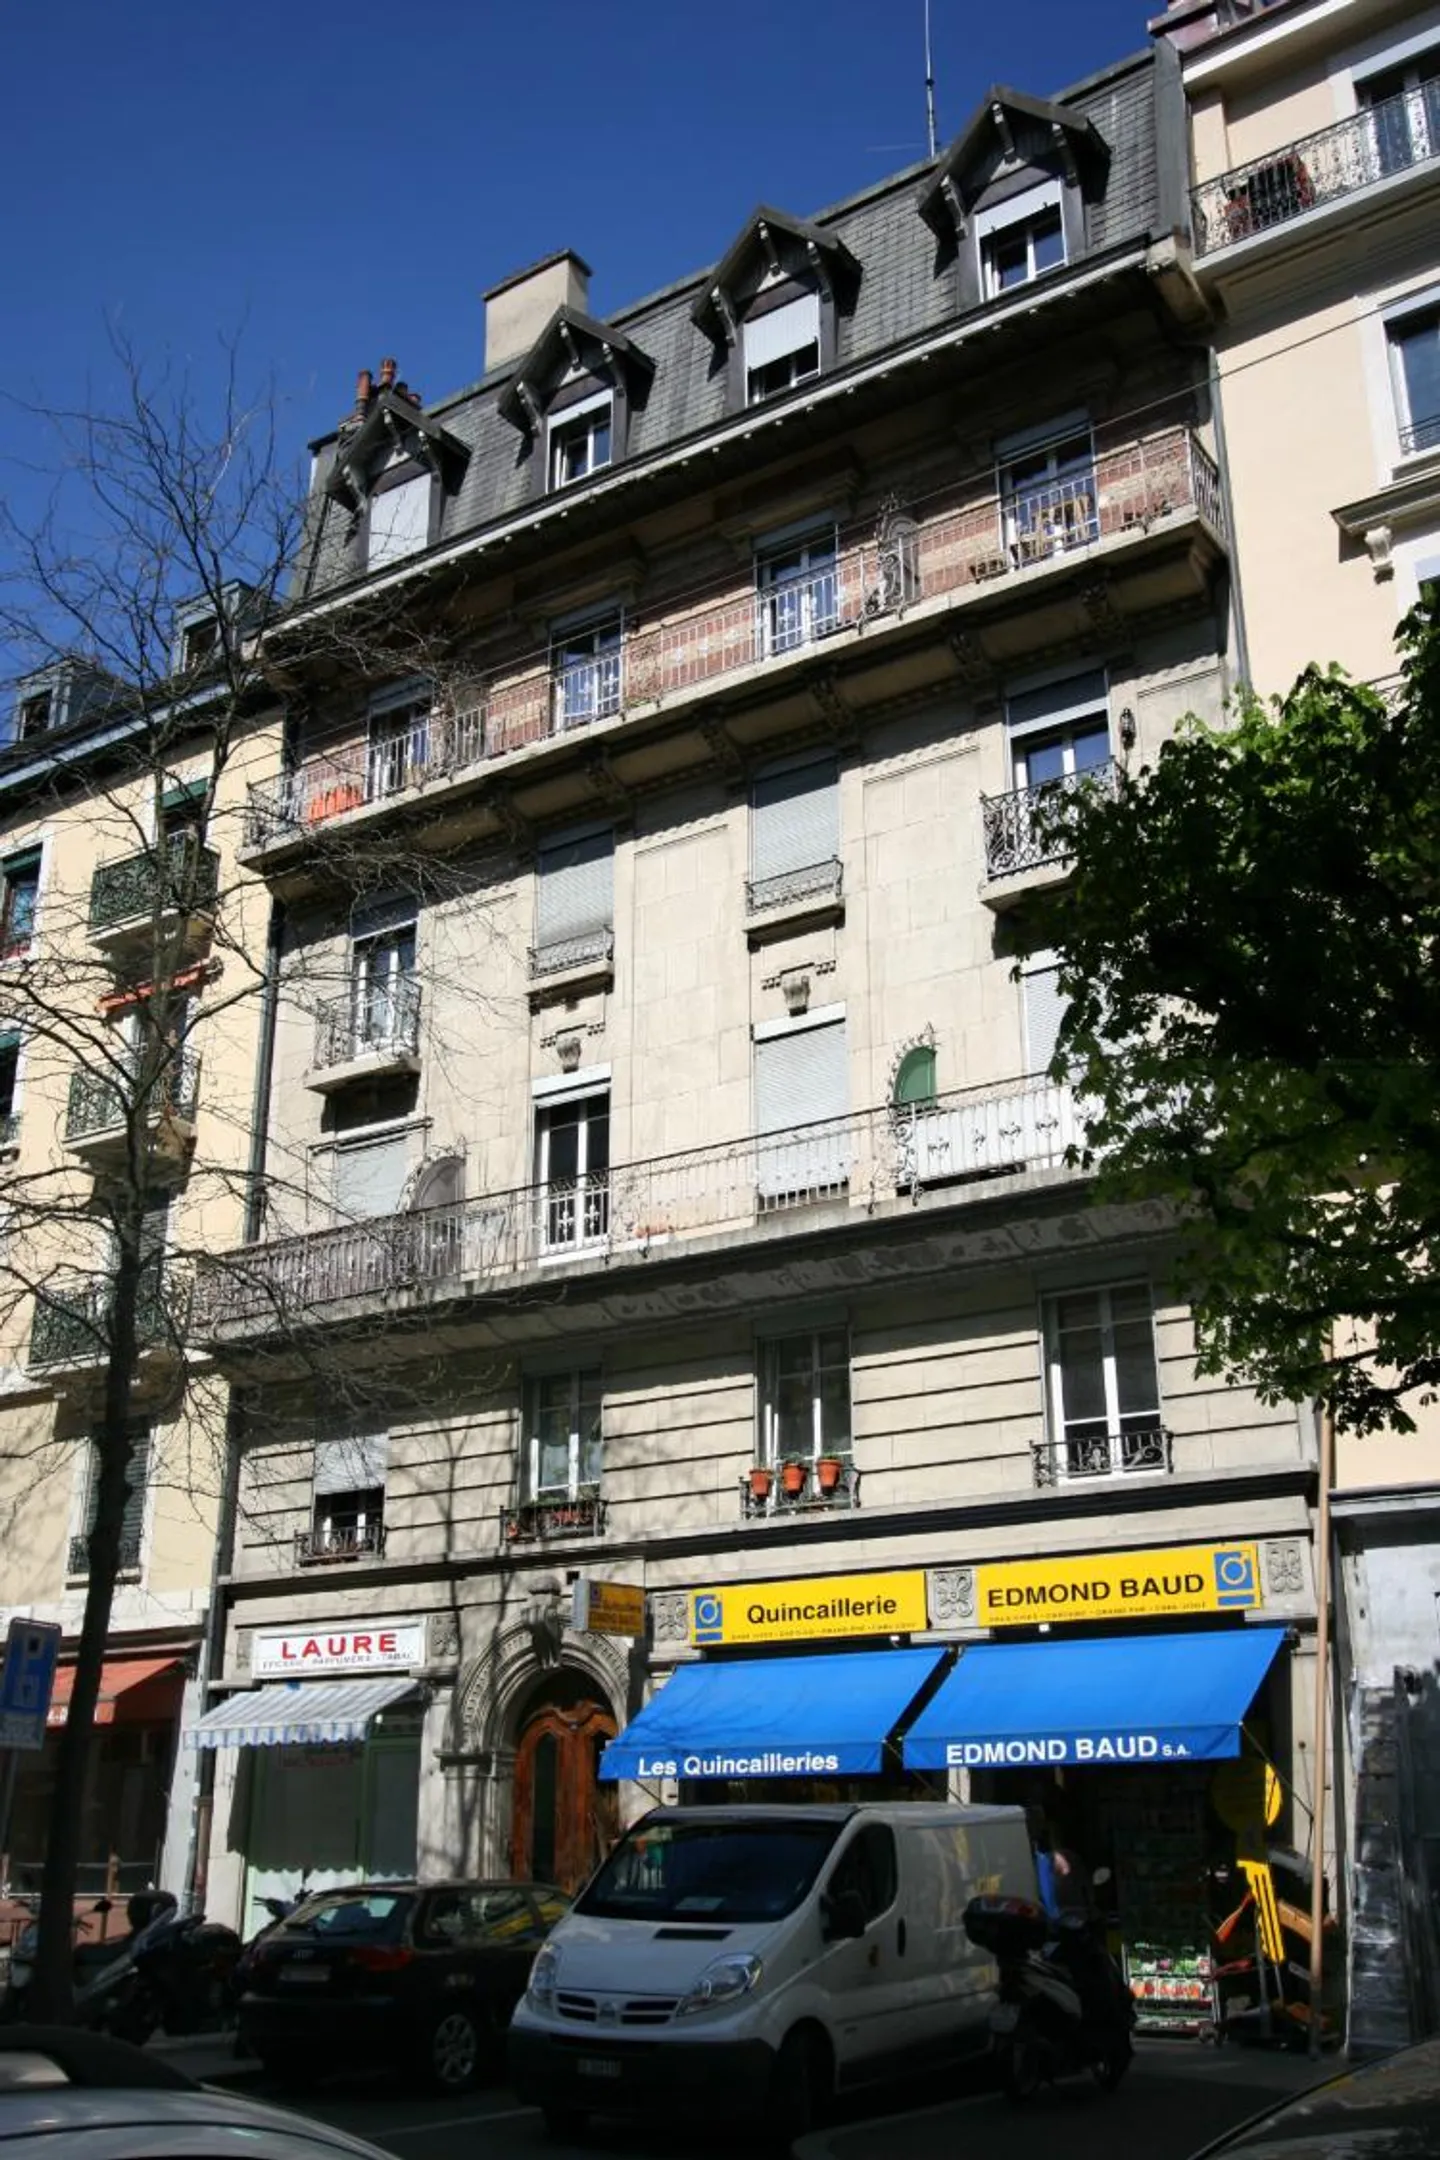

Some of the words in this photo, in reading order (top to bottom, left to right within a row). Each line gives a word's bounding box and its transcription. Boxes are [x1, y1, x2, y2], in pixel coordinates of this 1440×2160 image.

[988, 1581, 1110, 1608] EDMOND
[1120, 1573, 1205, 1598] BAUD
[747, 1595, 897, 1624] Quincaillerie
[282, 1633, 397, 1660] LAURE
[638, 1757, 677, 1776] Les
[684, 1751, 839, 1776] Quincailleries
[946, 1739, 1067, 1765] EDMOND
[1075, 1735, 1158, 1760] BAUD
[1161, 1743, 1191, 1757] S.A.
